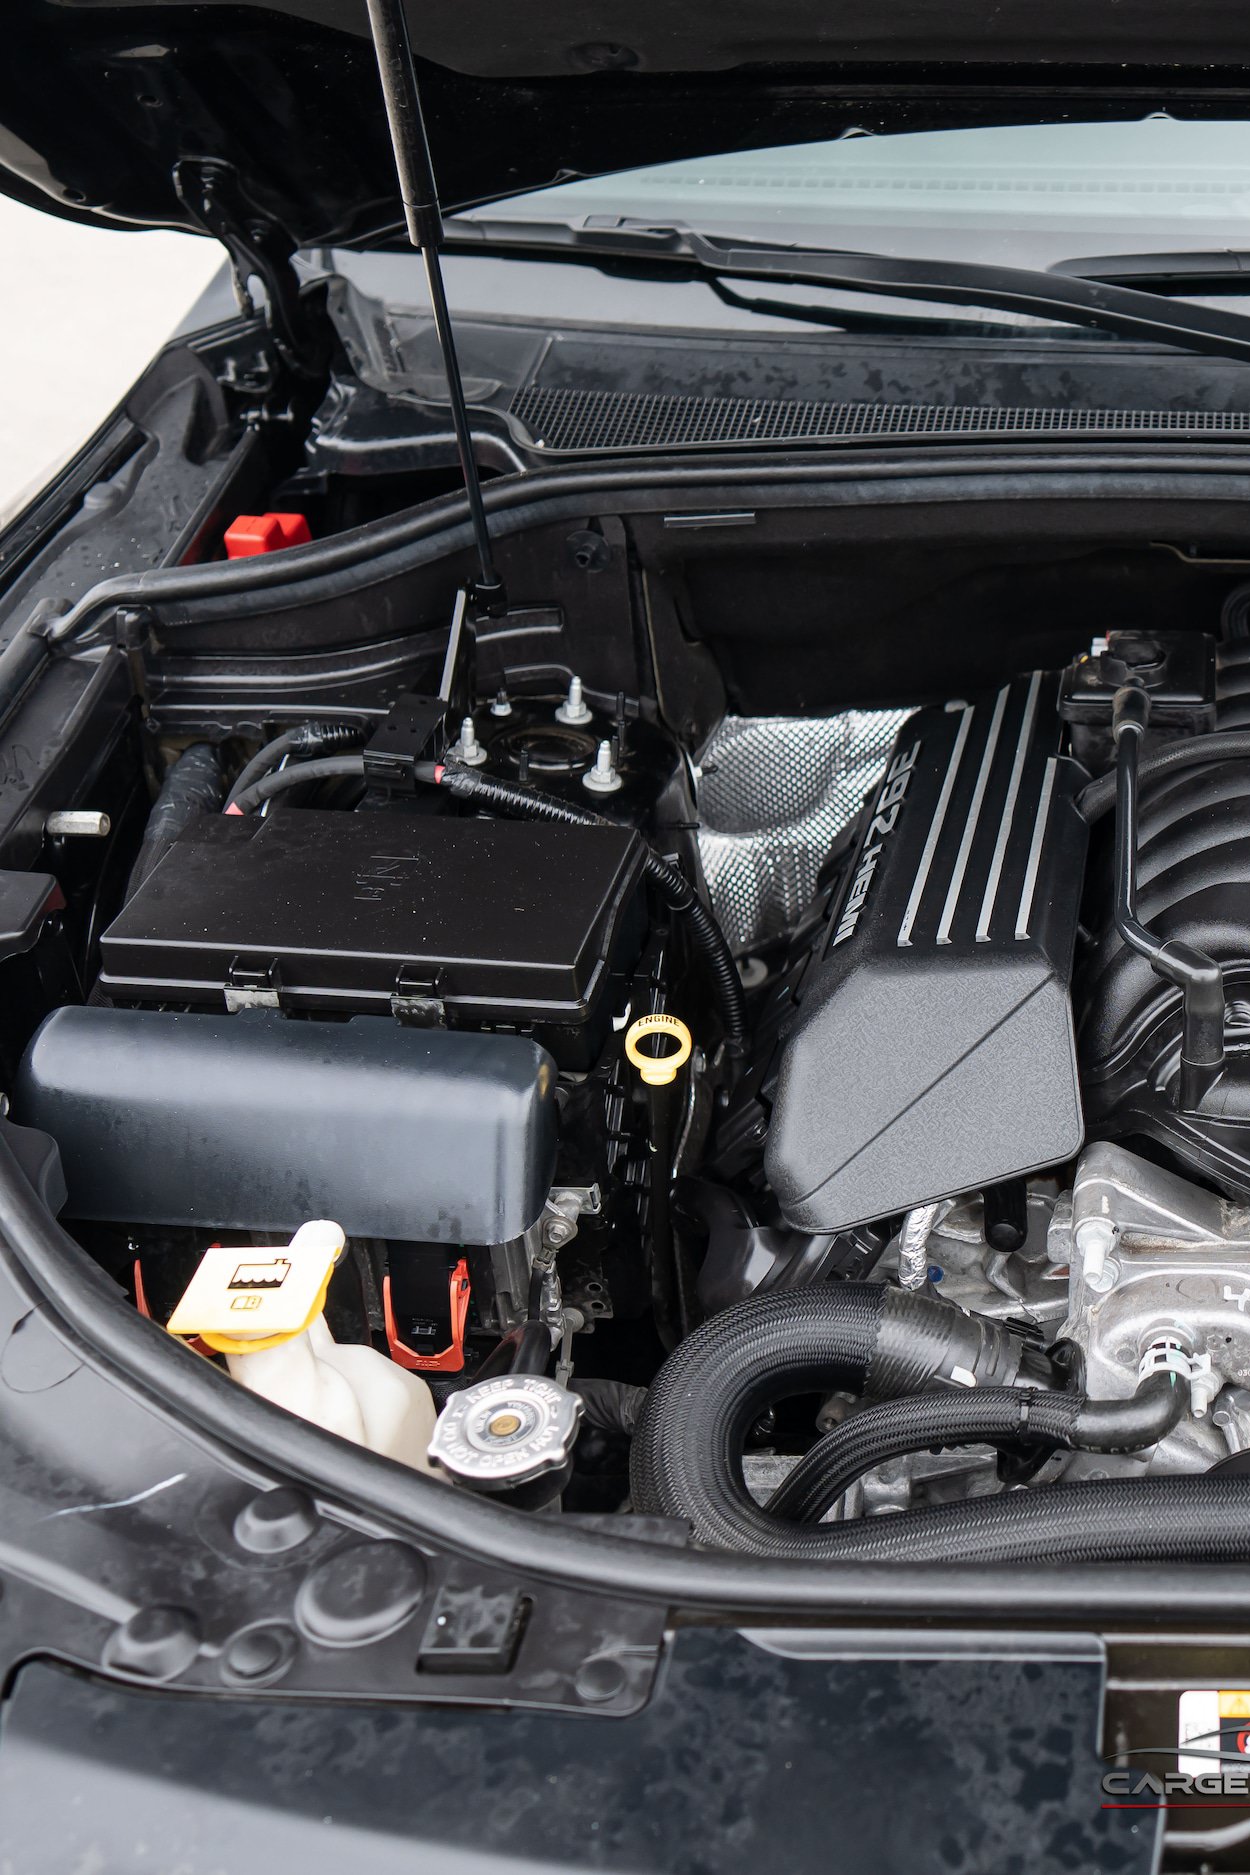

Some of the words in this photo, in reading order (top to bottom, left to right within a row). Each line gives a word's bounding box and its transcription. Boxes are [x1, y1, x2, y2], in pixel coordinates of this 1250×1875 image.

[862, 740, 922, 849] 392
[832, 844, 883, 947] HEMI
[638, 1015, 680, 1027] ENGINE
[465, 1378, 515, 1404] KEEP
[522, 1378, 563, 1404] TIGHT
[479, 1447, 531, 1468] OPEN
